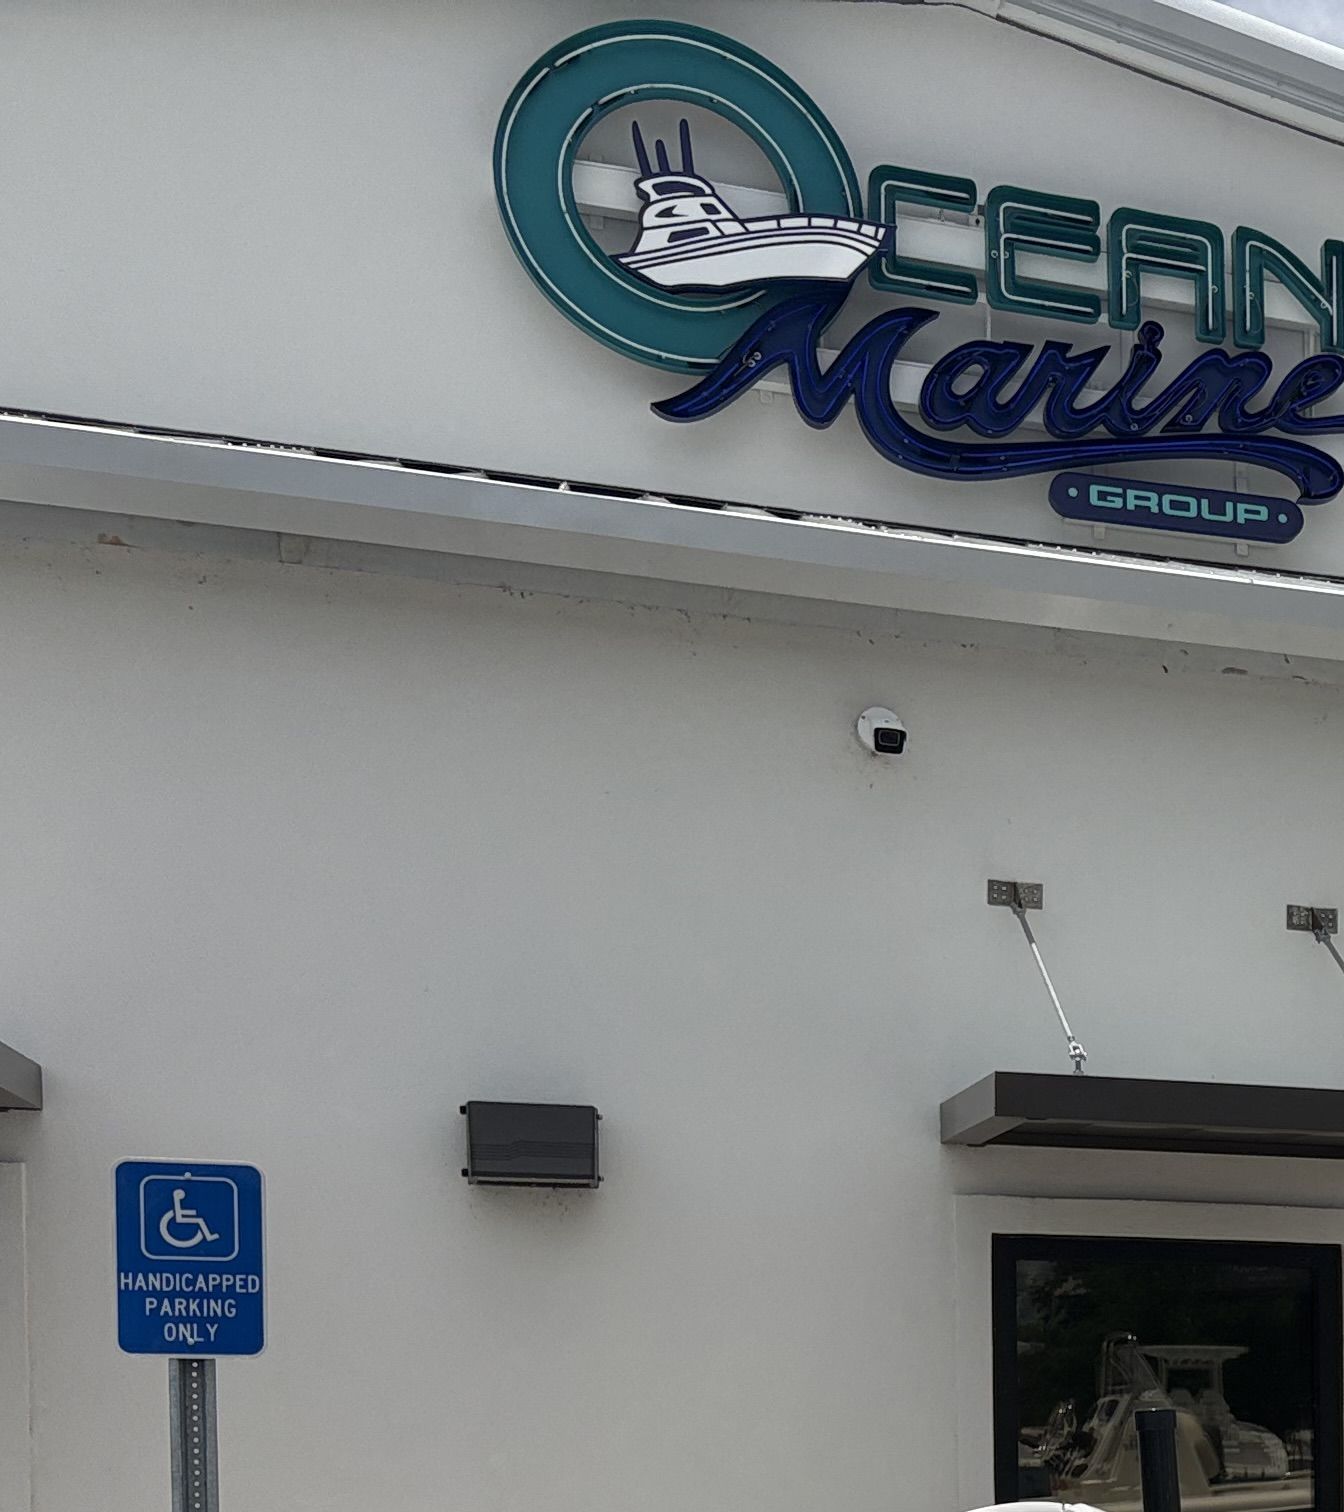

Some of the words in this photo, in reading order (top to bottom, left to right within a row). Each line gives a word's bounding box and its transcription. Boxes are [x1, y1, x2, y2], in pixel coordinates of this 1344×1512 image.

[1088, 483, 1270, 525] GROUP
[119, 1271, 261, 1294] HANDICAPPED
[145, 1297, 237, 1318] PARKING
[163, 1322, 219, 1343] ONLY
